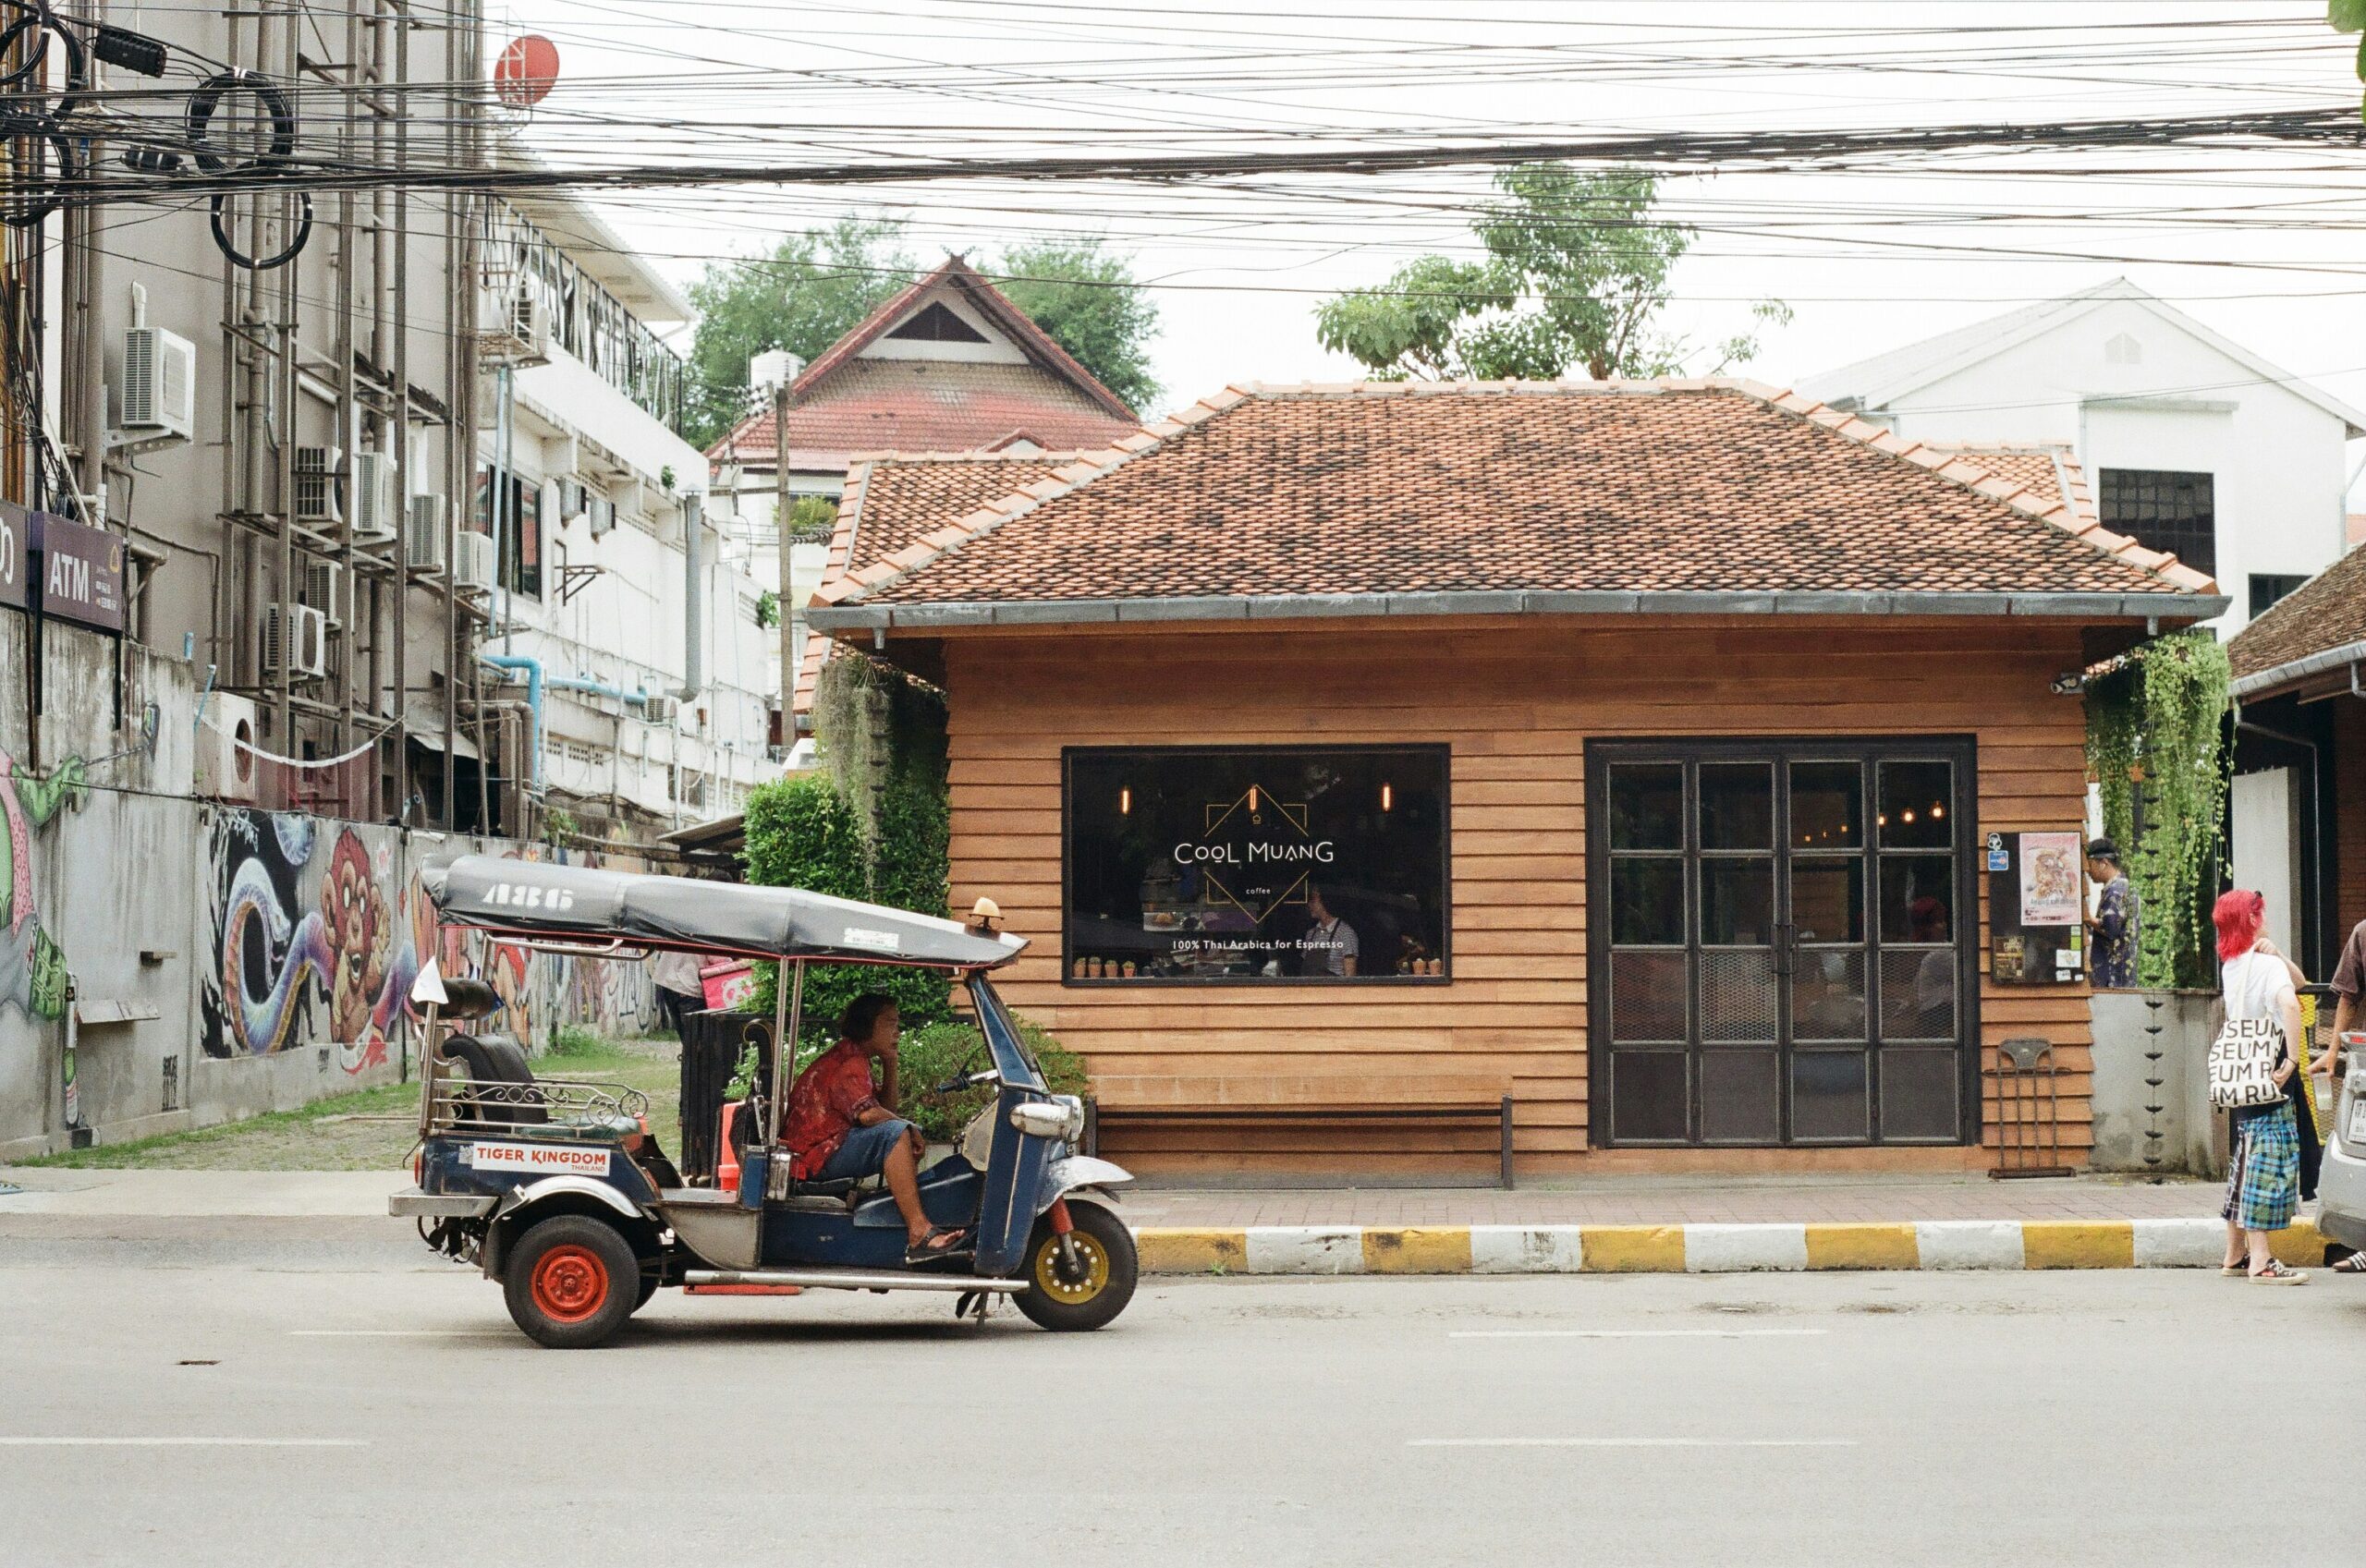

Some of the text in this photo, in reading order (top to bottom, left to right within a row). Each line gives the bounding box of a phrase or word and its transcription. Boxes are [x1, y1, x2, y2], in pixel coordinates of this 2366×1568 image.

[49, 552, 89, 603] ATM
[1173, 939, 1344, 951] 100% Thai Arabica for Espresso
[477, 1148, 606, 1165] TIGER KINGDOM
[571, 1164, 605, 1173] THAILAND
